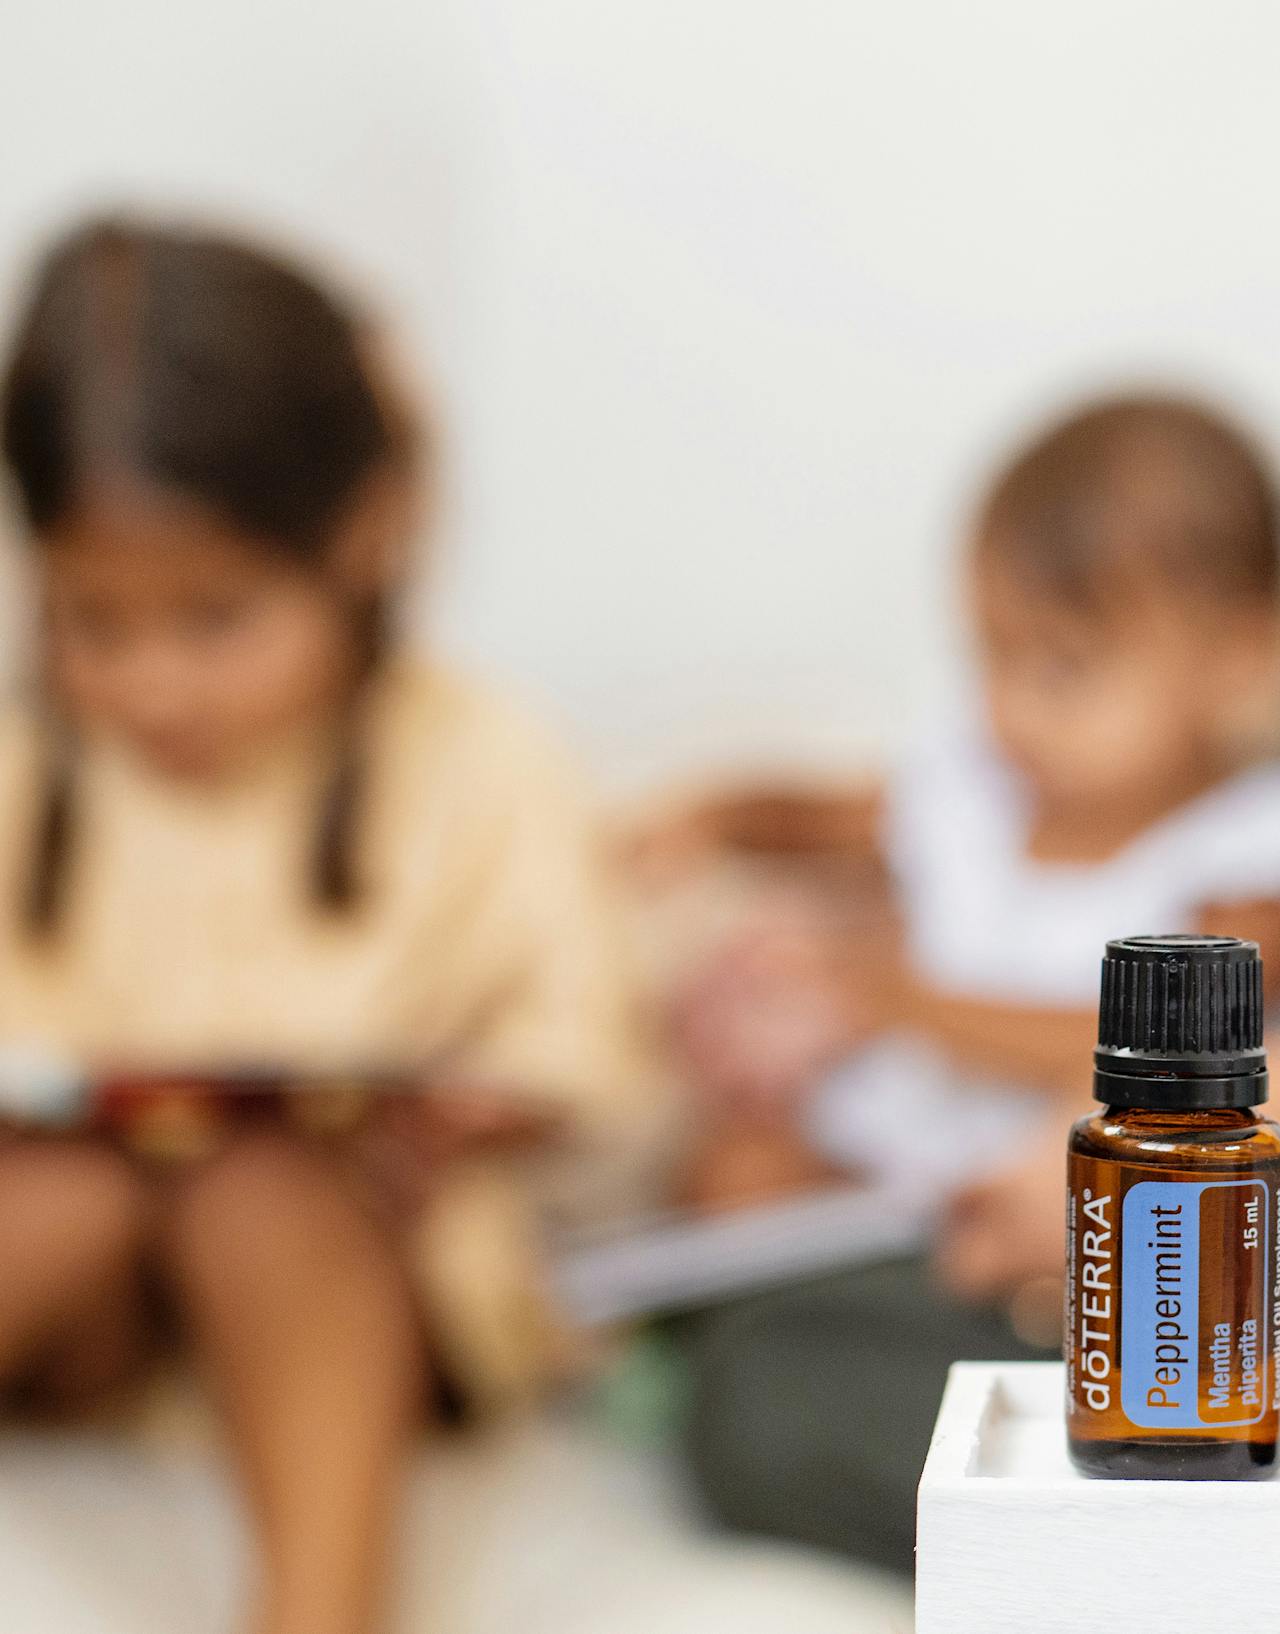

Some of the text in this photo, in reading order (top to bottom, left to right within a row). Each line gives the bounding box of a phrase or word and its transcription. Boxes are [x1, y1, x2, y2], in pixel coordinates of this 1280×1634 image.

[1244, 1196, 1259, 1249] 15 mL
[1147, 1204, 1188, 1408] Peppermint
[1208, 1322, 1231, 1408] Mentha
[1237, 1319, 1257, 1406] piperita
